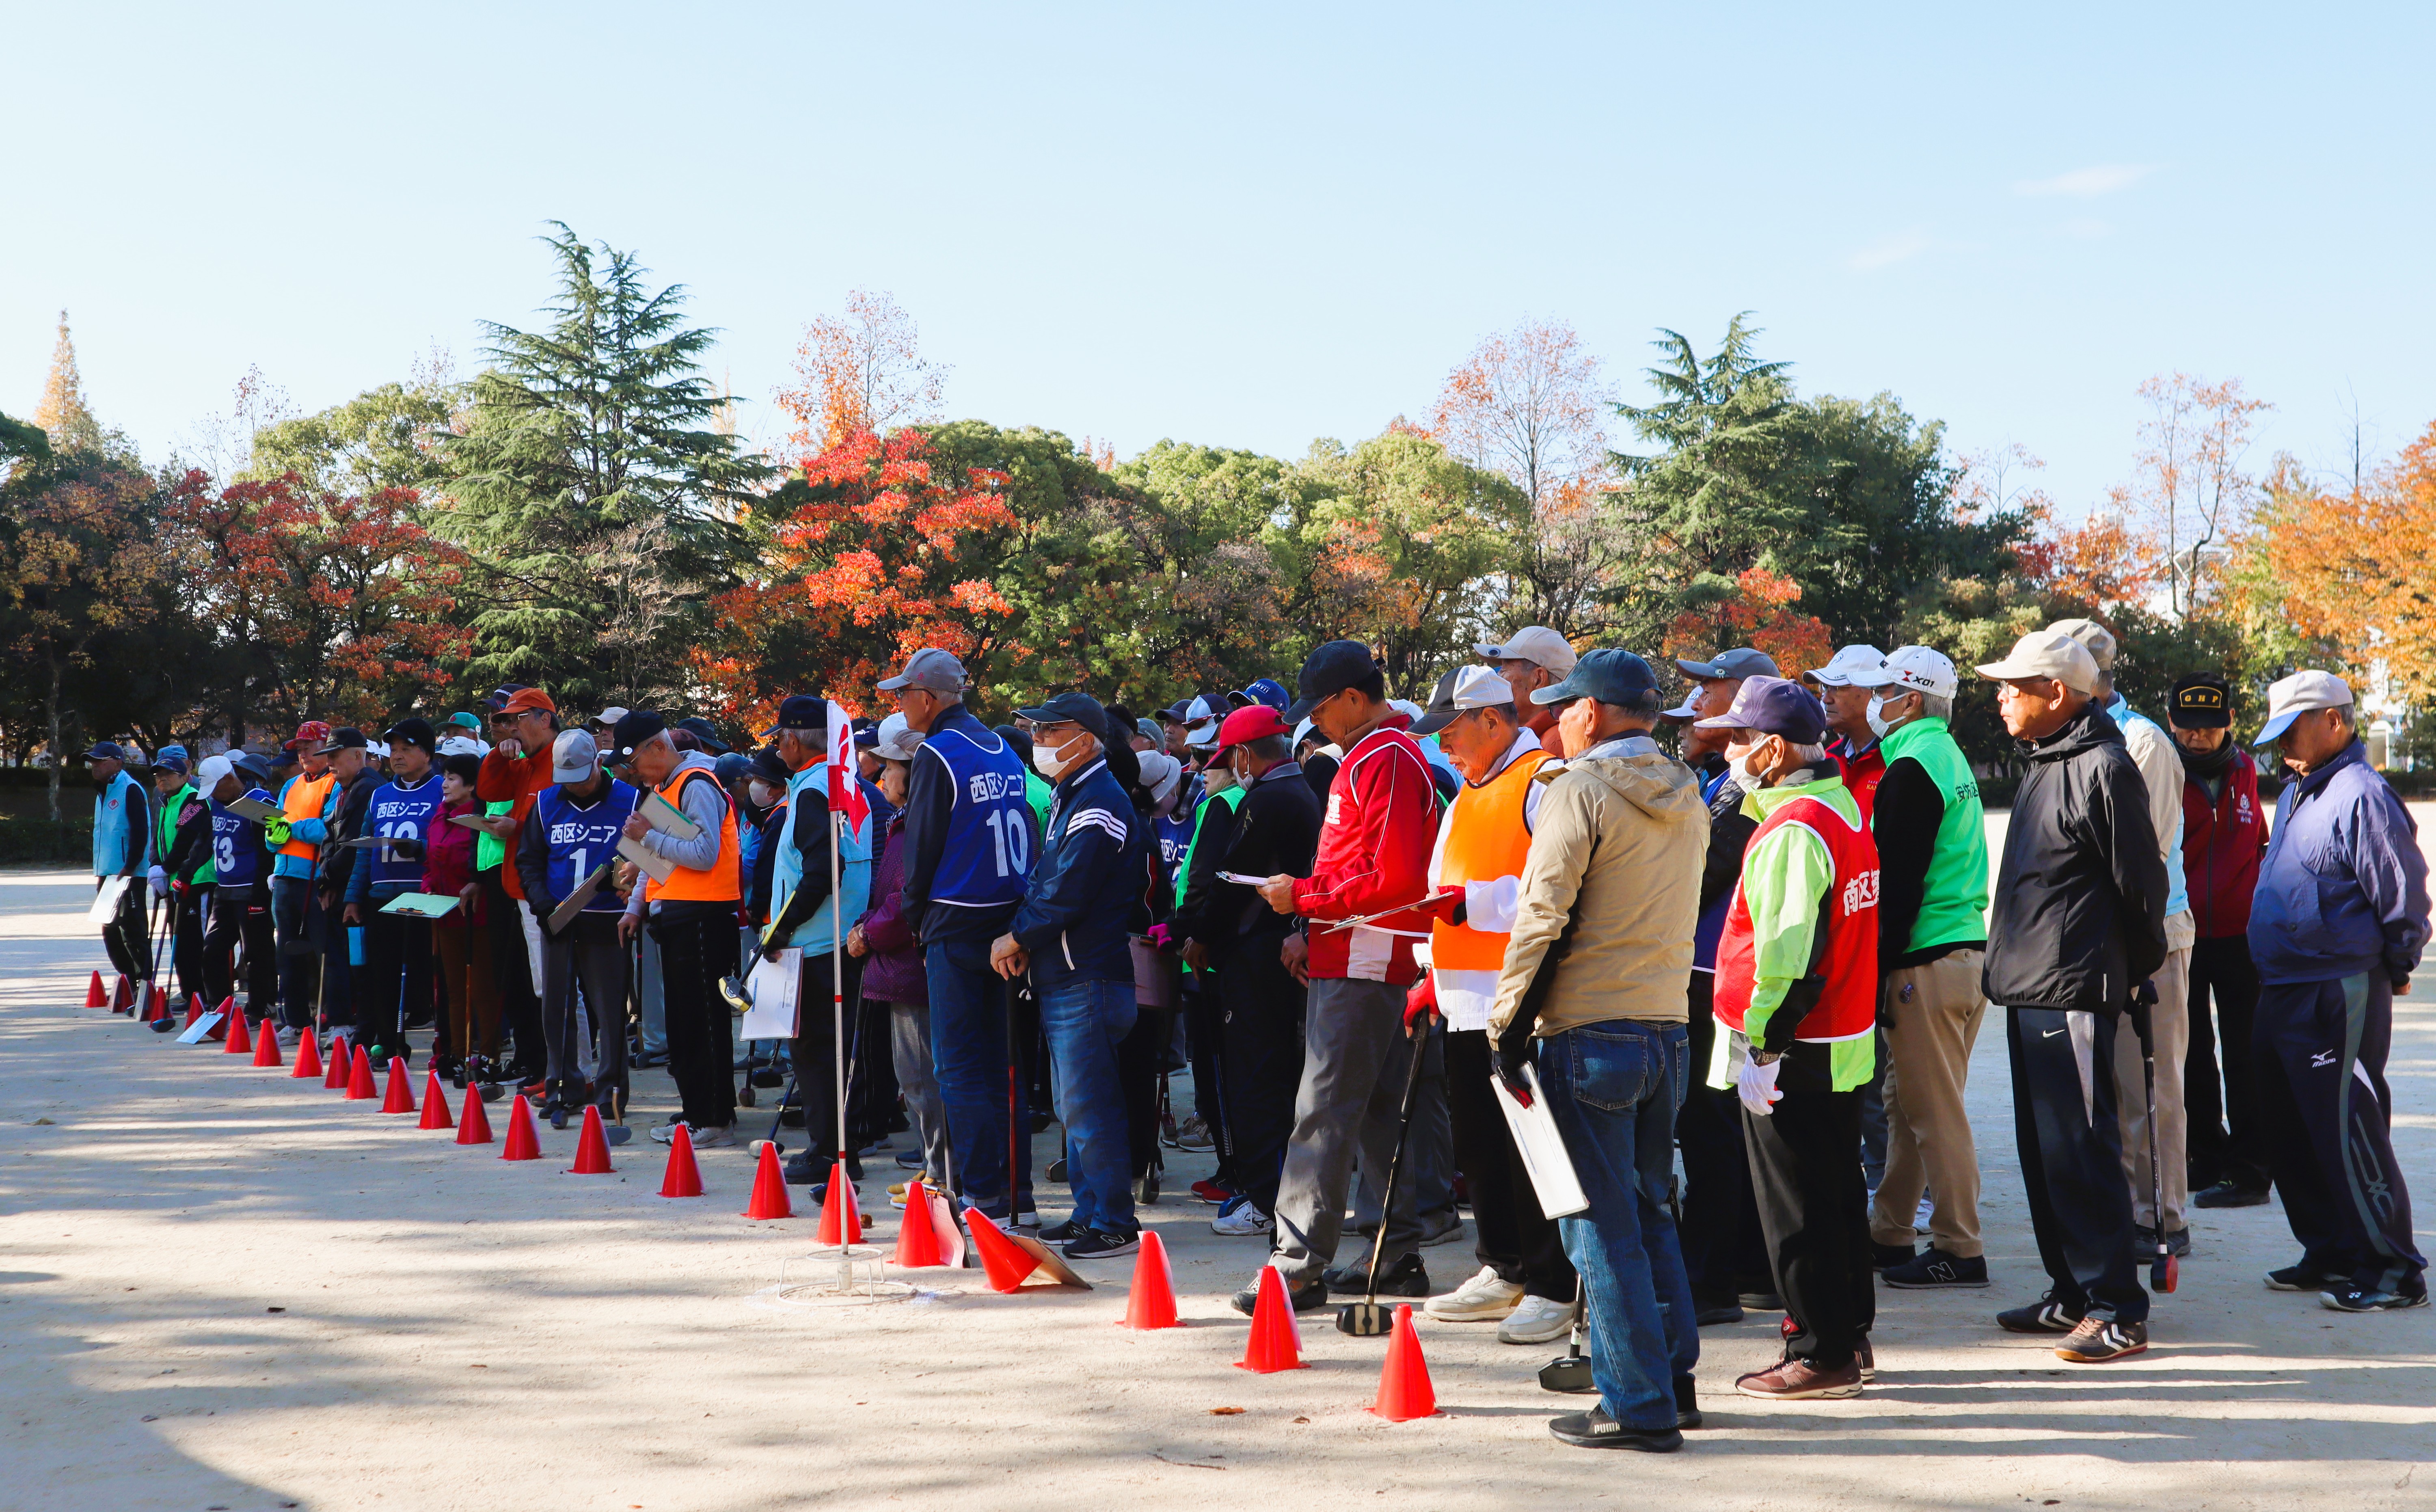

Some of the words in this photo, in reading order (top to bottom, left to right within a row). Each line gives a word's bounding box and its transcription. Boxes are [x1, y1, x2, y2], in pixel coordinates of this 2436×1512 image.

[376, 801, 432, 819] 西区シニア
[551, 823, 617, 845] 西区シニア
[986, 808, 1028, 877] 10
[212, 836, 235, 872] 13
[569, 848, 587, 892] 1
[2312, 1058, 2336, 1068] MIZUNO
[1594, 1421, 1621, 1434] PUMA
